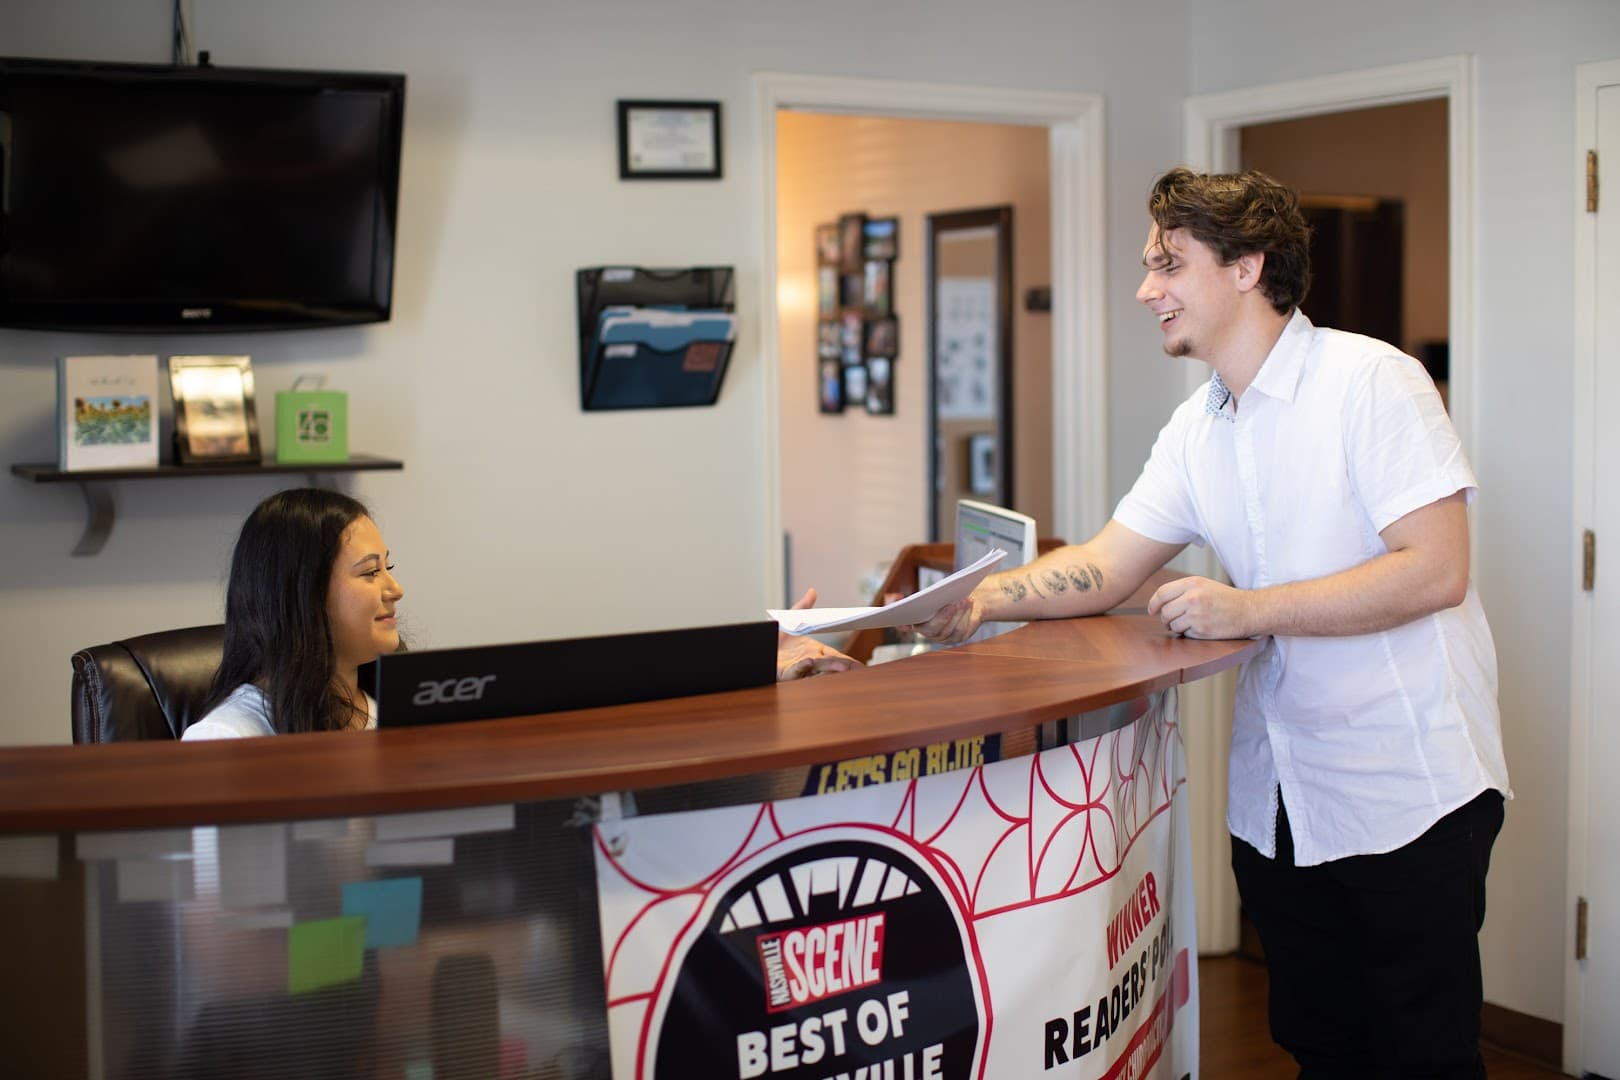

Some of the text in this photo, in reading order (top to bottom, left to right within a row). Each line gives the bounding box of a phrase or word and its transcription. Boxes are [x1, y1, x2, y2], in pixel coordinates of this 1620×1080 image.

[413, 675, 496, 705] acer
[761, 914, 884, 1006] NASHVILLE SCENE
[1106, 871, 1160, 970] WINNER
[736, 990, 909, 1080] BEST OF
